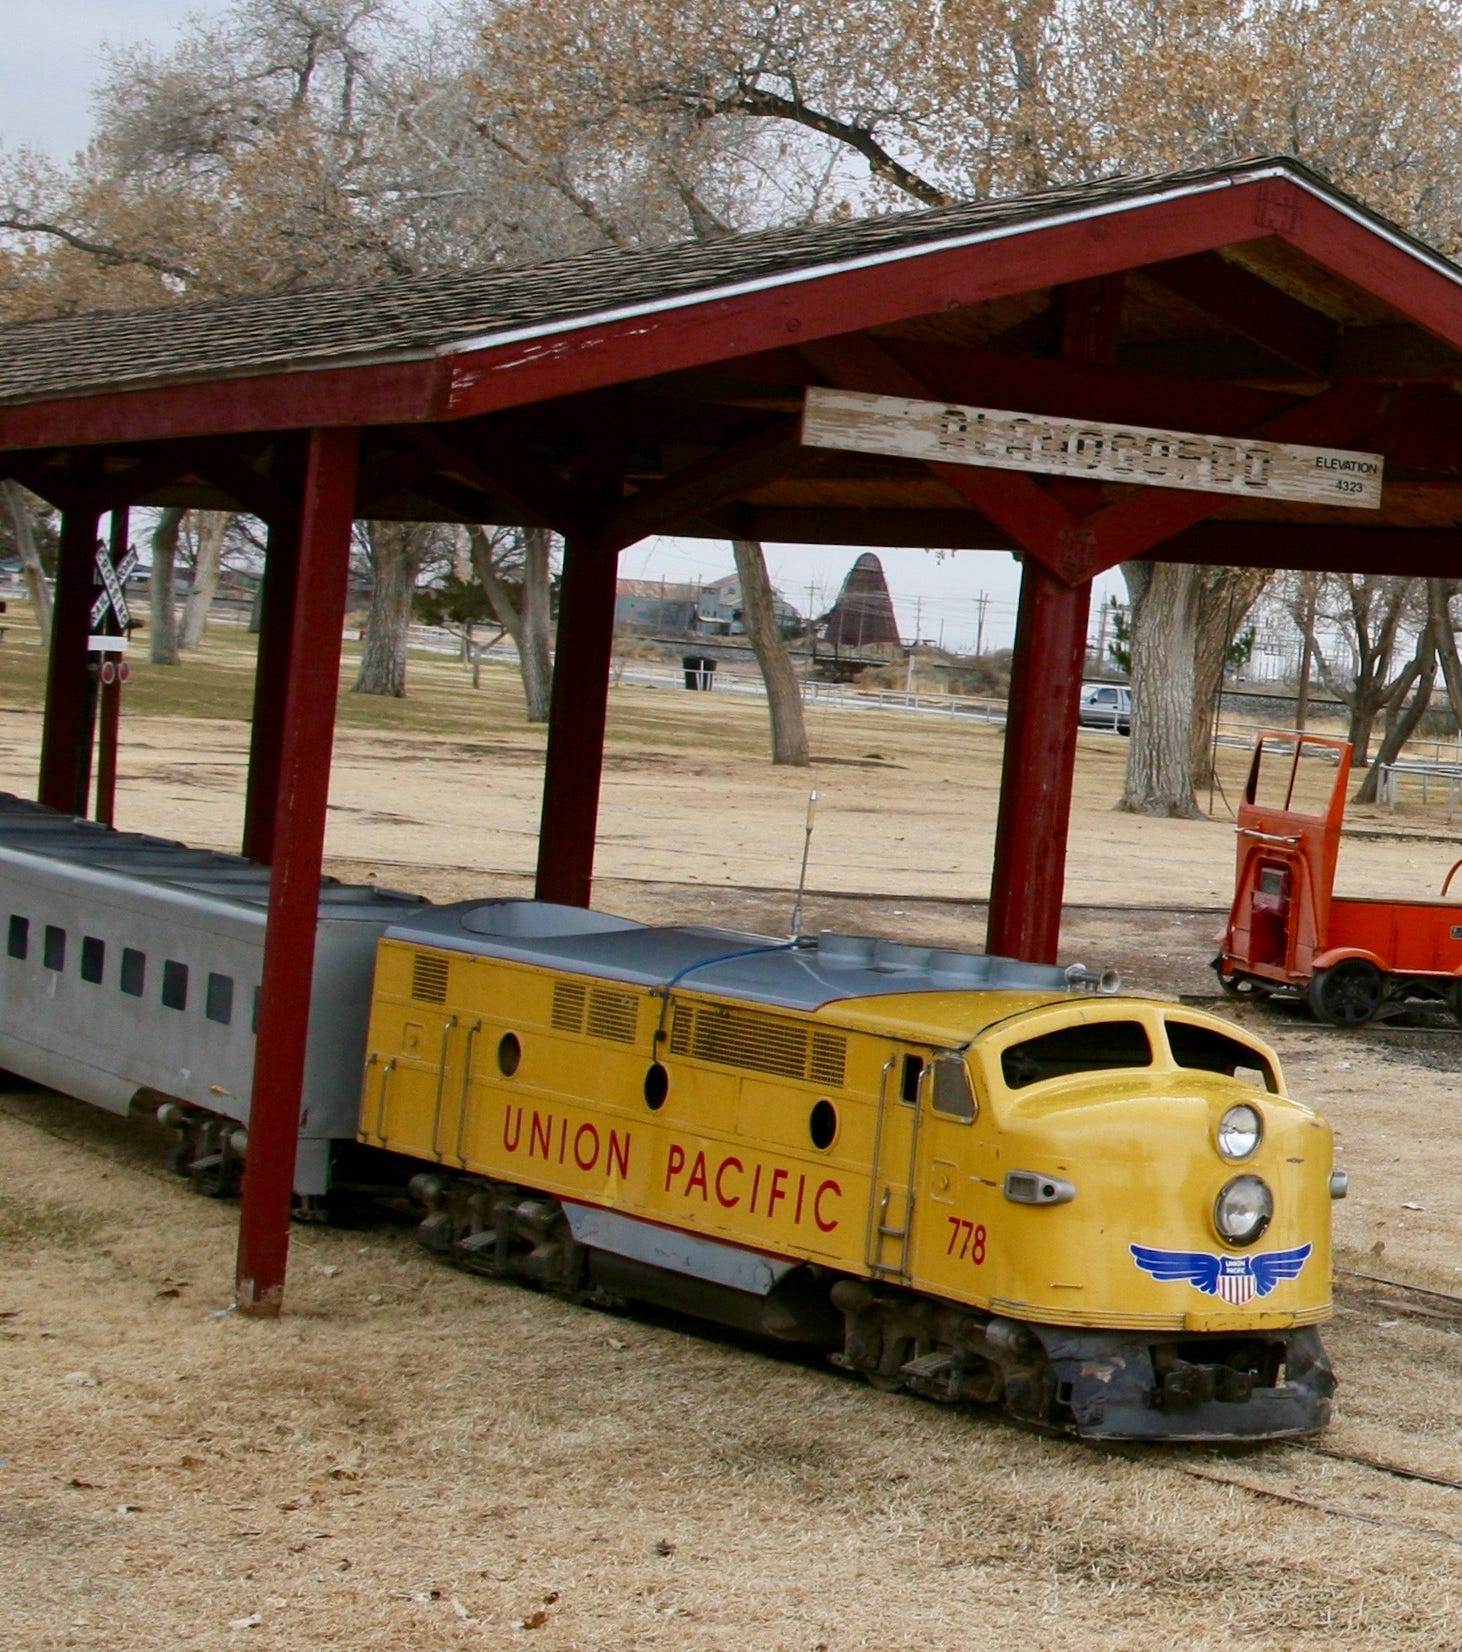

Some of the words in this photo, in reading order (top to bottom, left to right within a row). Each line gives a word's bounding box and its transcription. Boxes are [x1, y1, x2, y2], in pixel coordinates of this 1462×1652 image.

[1316, 456, 1378, 474] ELEVATION
[1336, 480, 1363, 493] 4323
[503, 1104, 631, 1180] UNION
[665, 1144, 843, 1233] PACIFIC
[947, 1216, 987, 1266] 778
